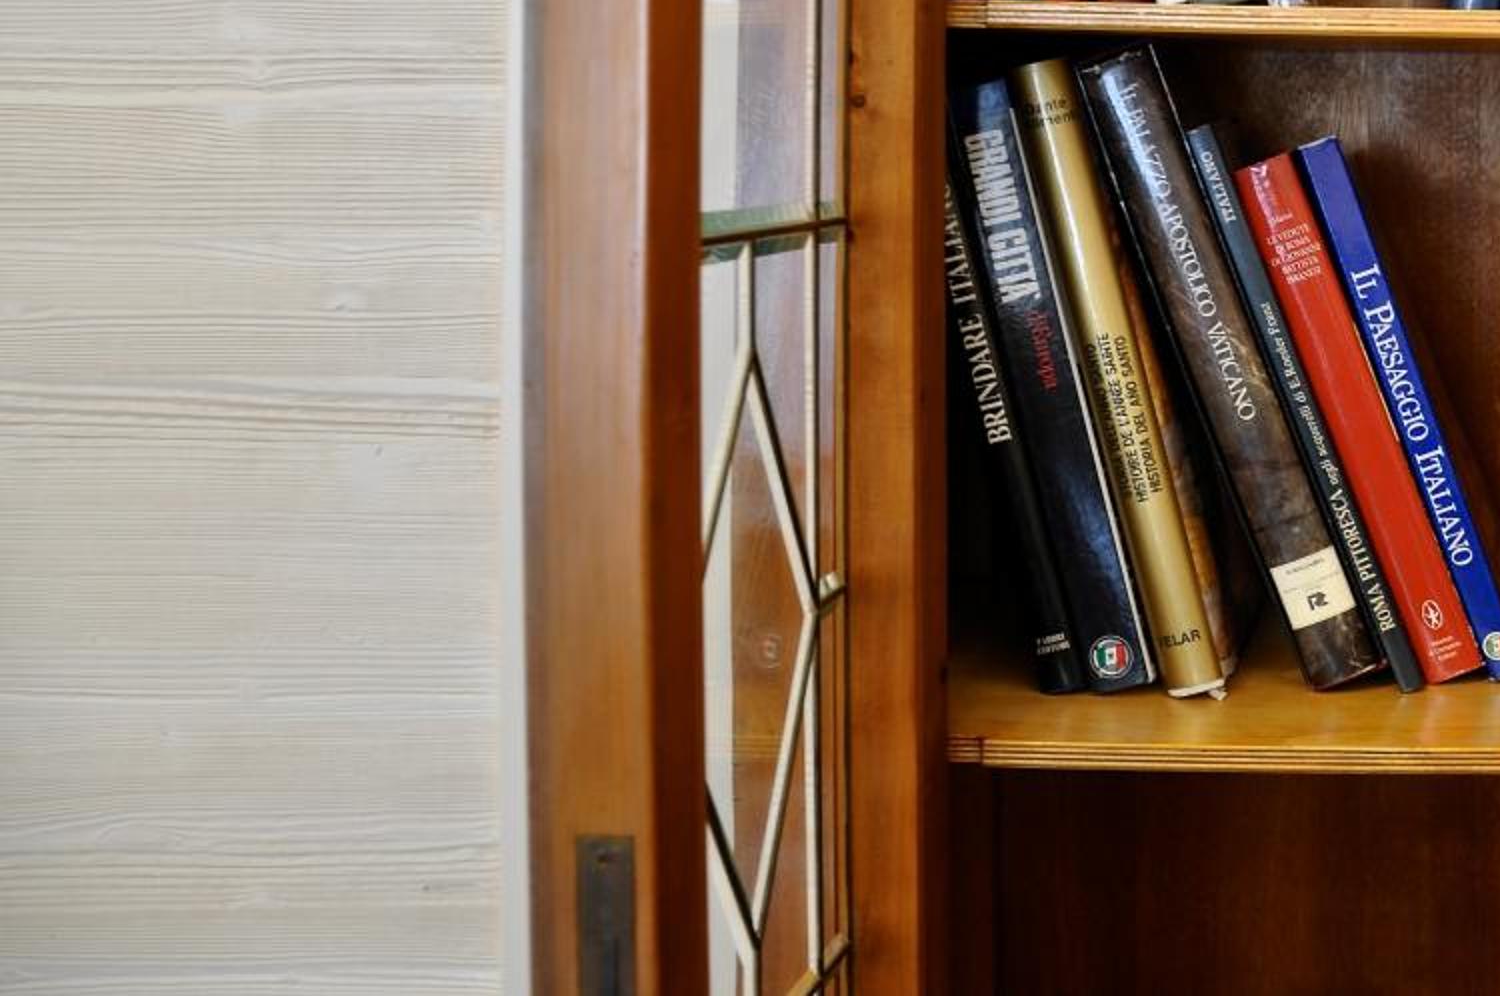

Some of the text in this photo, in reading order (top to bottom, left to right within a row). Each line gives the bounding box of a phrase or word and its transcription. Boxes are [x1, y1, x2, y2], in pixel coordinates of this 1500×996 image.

[963, 128, 1022, 227] GRANDI
[1199, 149, 1237, 223] ITALIANO
[1124, 106, 1174, 198] PALAZZO
[1159, 200, 1219, 318] APOSTOLICO
[1205, 320, 1258, 422] VATICANO
[1349, 262, 1386, 300] IL
[945, 182, 1012, 444] BRINDARE ITALIA
[1114, 335, 1135, 377] SANTO
[1363, 300, 1435, 444] PAESAGGIO
[1132, 412, 1148, 434] DEL
[1124, 449, 1148, 503] HISTOIRE
[1137, 438, 1162, 493] HISTORIA
[1327, 488, 1377, 581] PITTORESCA
[1413, 444, 1477, 569] ITALIANO
[1363, 582, 1397, 632] ROMA
